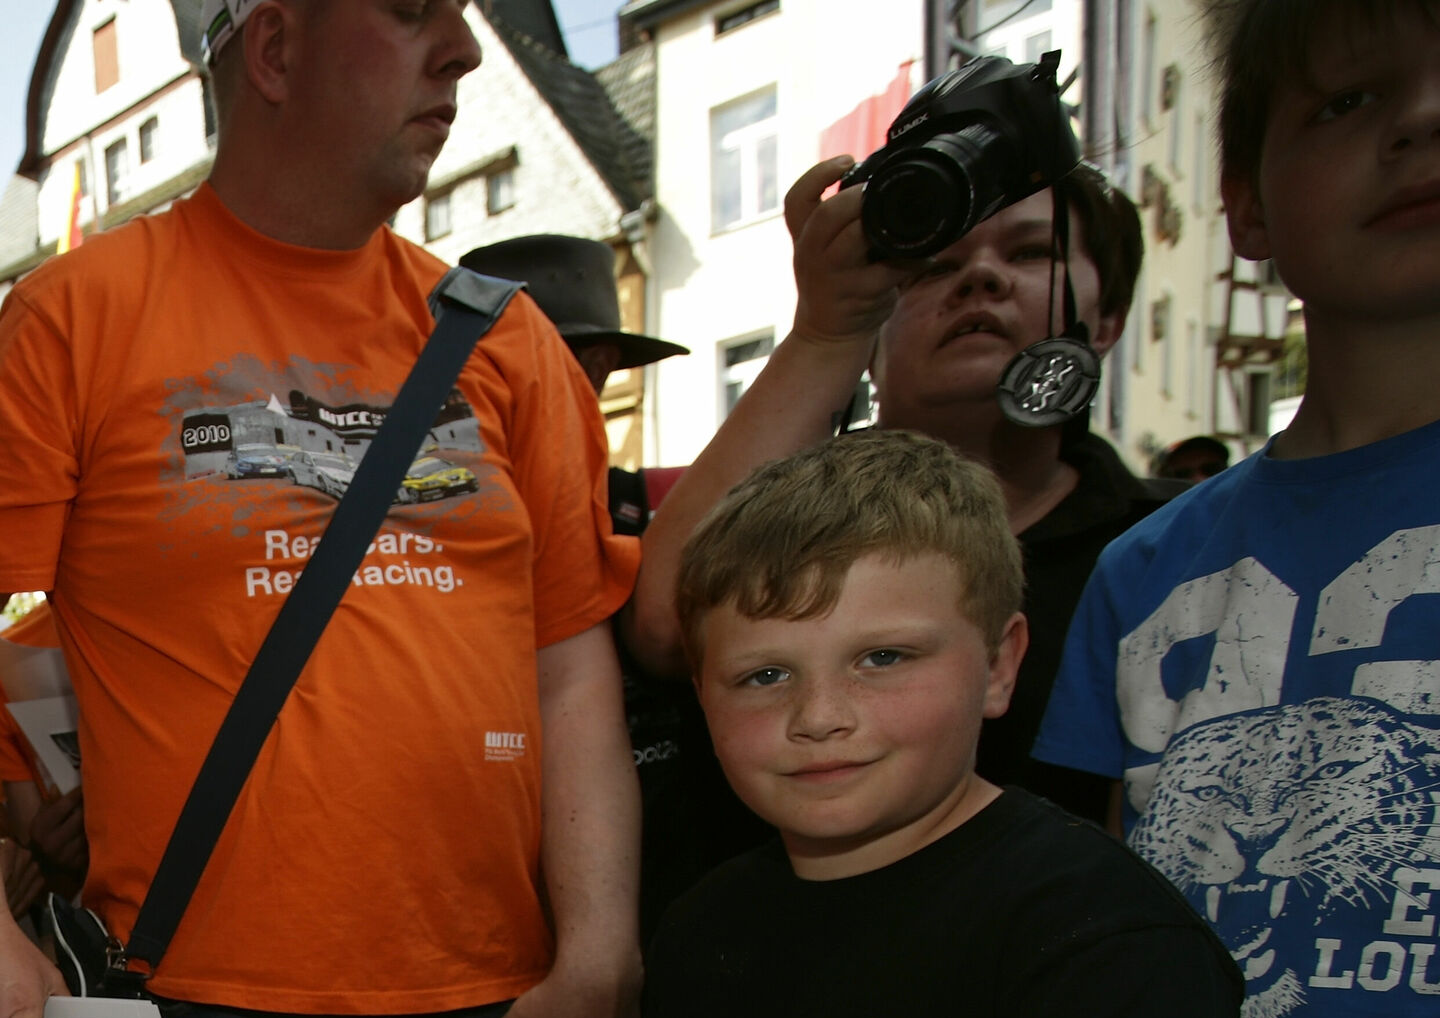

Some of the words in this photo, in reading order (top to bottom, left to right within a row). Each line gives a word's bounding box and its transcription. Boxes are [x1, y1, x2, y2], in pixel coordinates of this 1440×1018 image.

[182, 422, 231, 447] 2010
[264, 529, 323, 560] Rea
[365, 531, 445, 556] ars.
